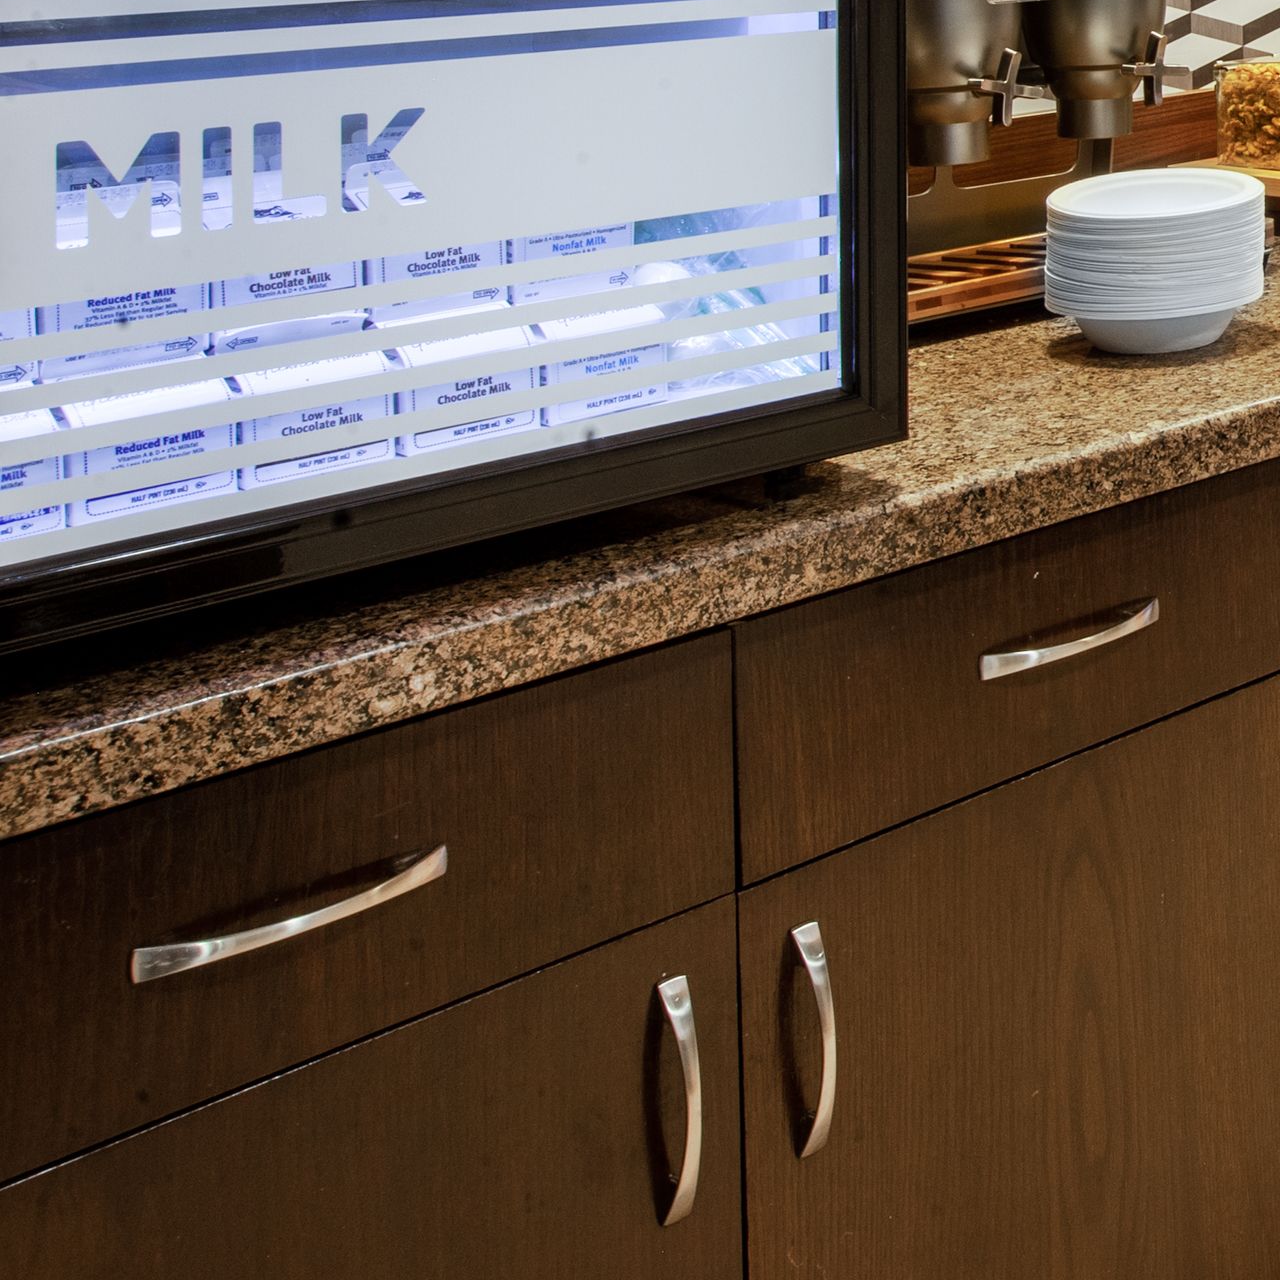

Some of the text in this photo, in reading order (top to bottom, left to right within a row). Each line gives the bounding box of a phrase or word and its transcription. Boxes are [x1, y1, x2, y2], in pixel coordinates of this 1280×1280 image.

[56, 107, 425, 250] MILK
[551, 235, 607, 252] Nonfat Milk
[424, 246, 463, 261] Low Fat
[407, 252, 481, 273] Chocolate Milk
[249, 272, 331, 294] Chocolate Milk
[87, 287, 176, 308] Reduced Fat Milk
[254, 290, 276, 299] Vitamin
[91, 305, 115, 314] Vitamin
[100, 312, 115, 320] Less
[141, 305, 164, 314] Regular
[585, 361, 616, 374] Nonfat
[618, 355, 640, 367] Milk
[455, 376, 493, 392] Low Fat
[437, 381, 511, 405] Chocolate Milk
[586, 400, 604, 410] HALF
[603, 397, 618, 406] PINT
[631, 391, 643, 400] mL)
[302, 406, 343, 422] Low Fat
[281, 412, 364, 437] Chocolate Milk
[453, 428, 466, 436] HALF
[467, 425, 479, 434] PINT
[115, 429, 206, 455] Reduced Fat Milk
[117, 453, 142, 463] Vitamin
[178, 442, 199, 451] Milkfat
[313, 458, 326, 466] PINT
[0, 469, 28, 482] Milk
[131, 494, 146, 503] HALF
[147, 491, 162, 500] PINT
